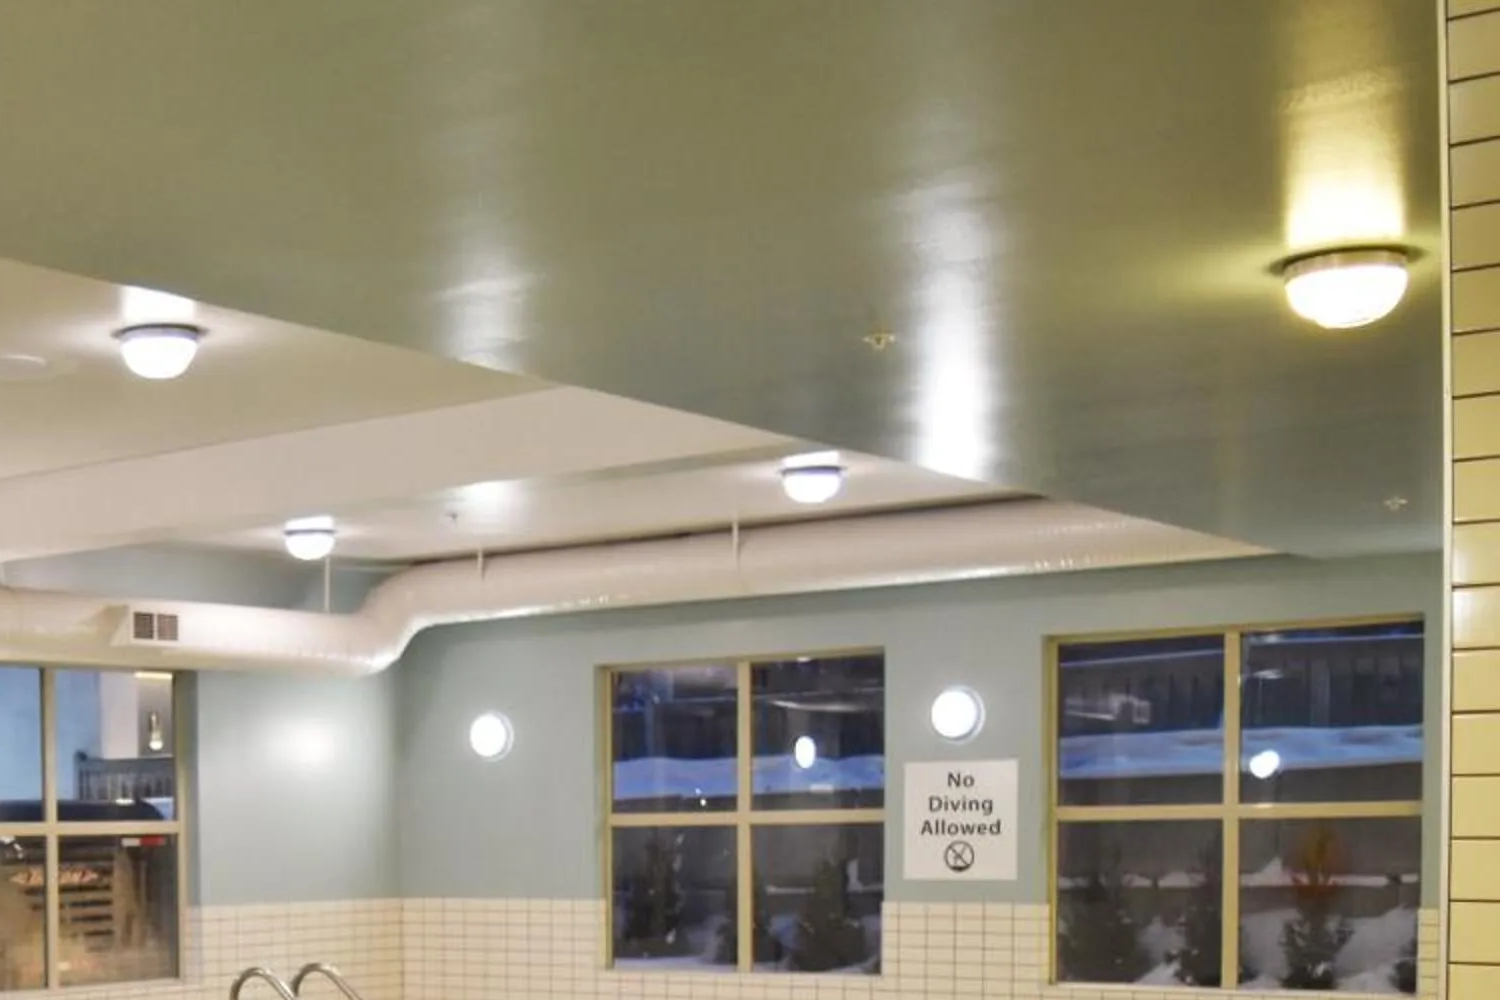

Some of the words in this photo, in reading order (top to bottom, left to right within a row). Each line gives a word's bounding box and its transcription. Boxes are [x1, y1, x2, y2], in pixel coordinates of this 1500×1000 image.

[947, 771, 975, 788] No
[928, 795, 994, 816] Diving
[920, 819, 1001, 836] Allowed
